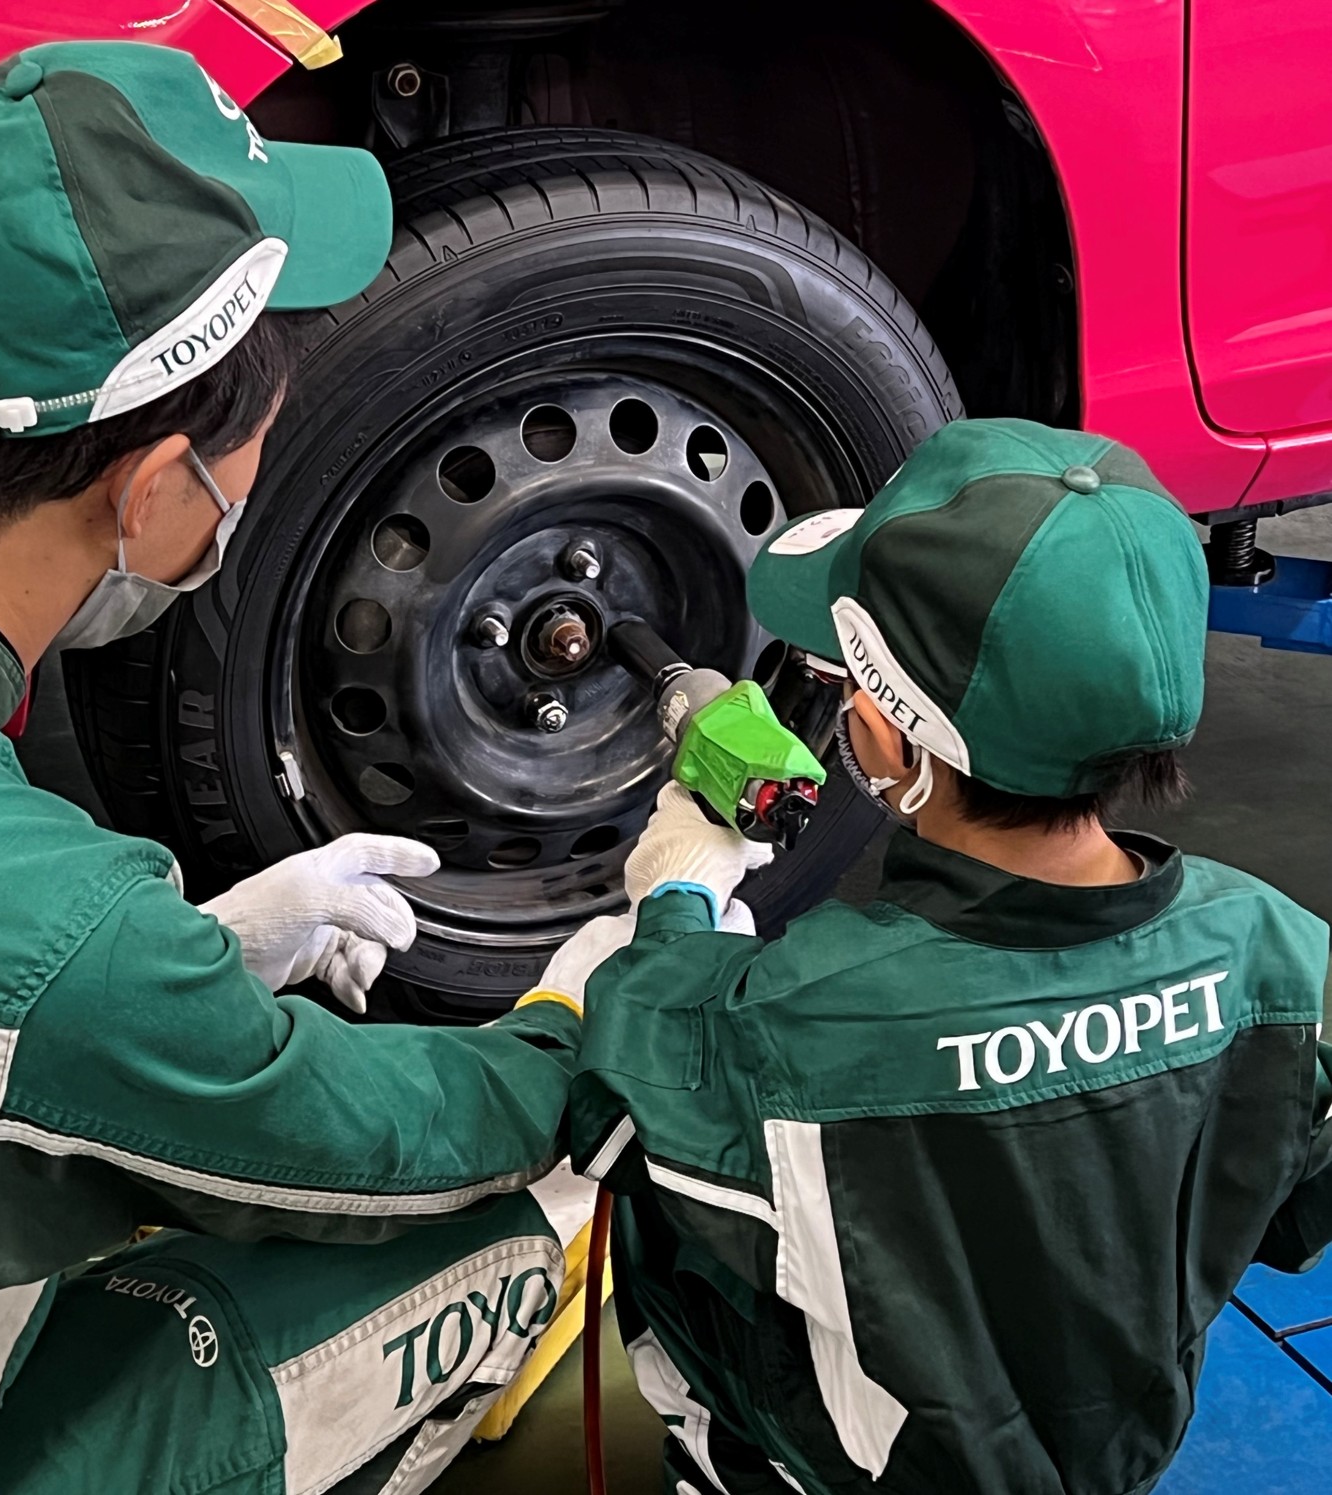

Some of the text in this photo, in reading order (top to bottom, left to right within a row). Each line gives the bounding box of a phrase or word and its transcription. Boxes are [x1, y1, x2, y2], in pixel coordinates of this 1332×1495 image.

[150, 270, 257, 376] TOYOPET
[849, 621, 928, 733] TOYOPET
[177, 689, 238, 845] YEAR
[937, 971, 1229, 1091] TOYOPET
[104, 1275, 197, 1318] TOYOTA
